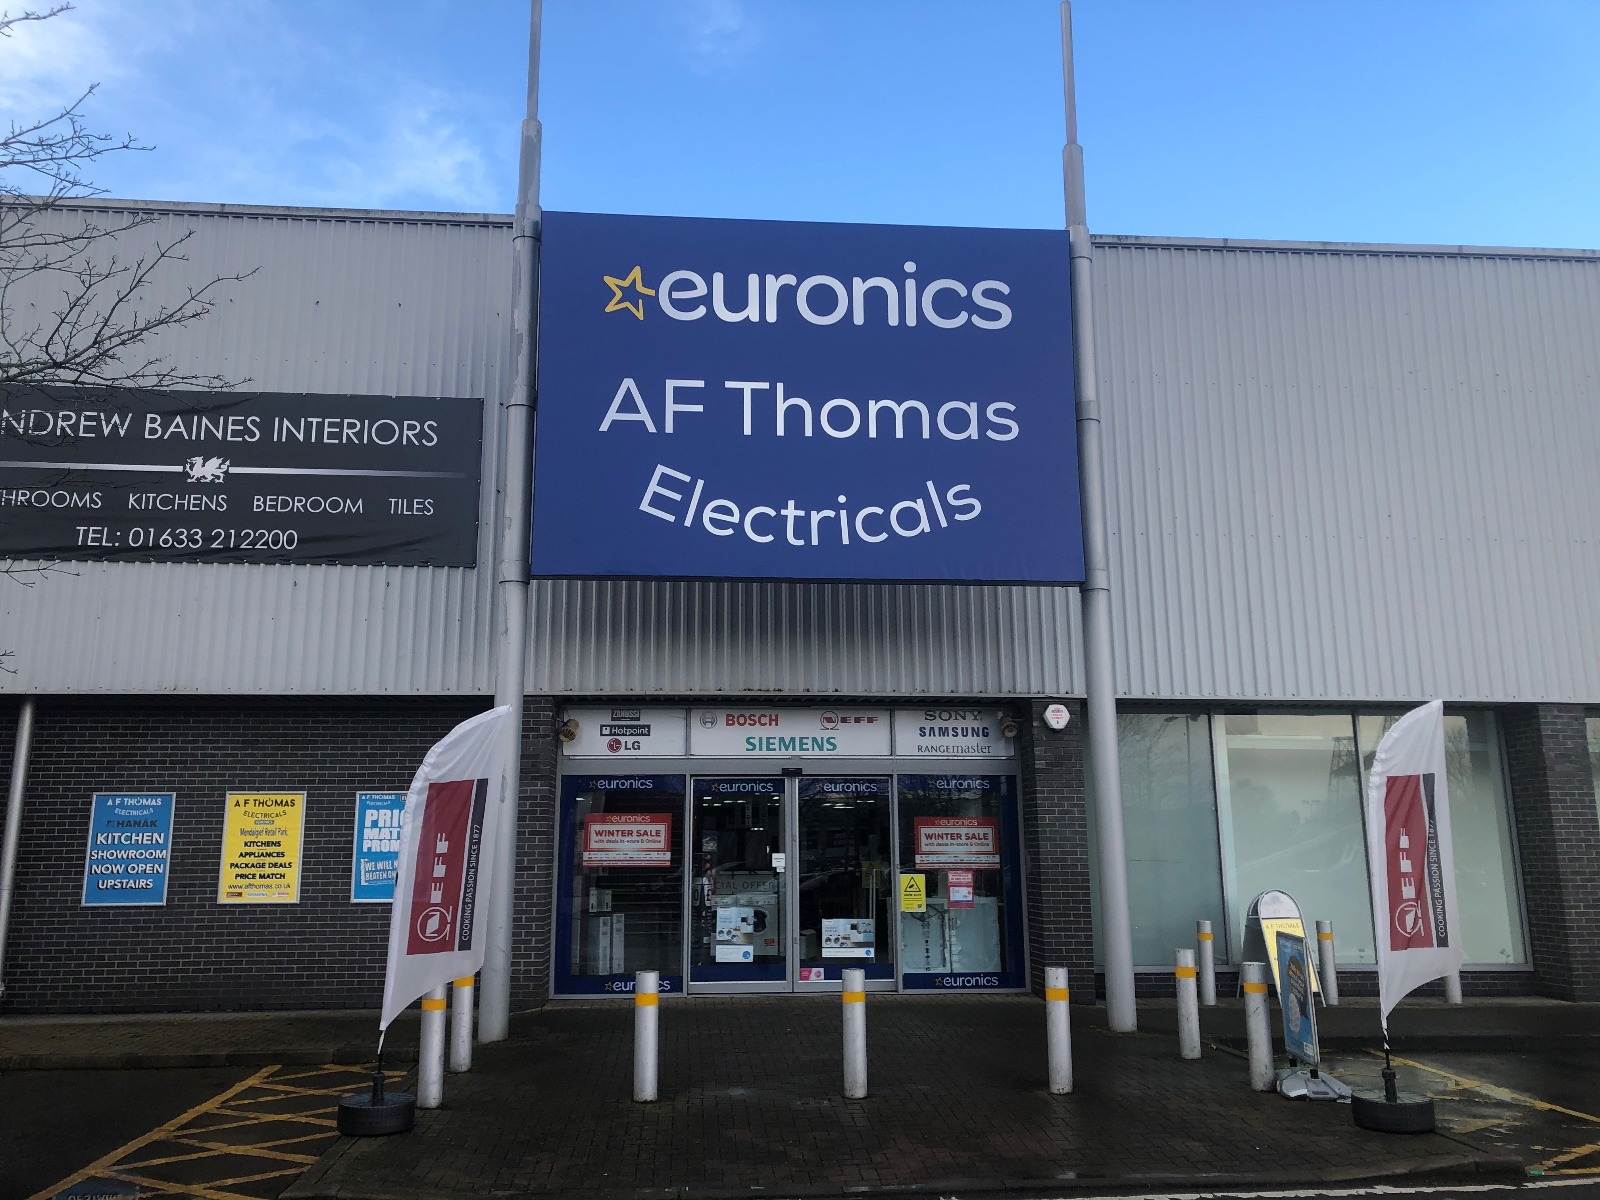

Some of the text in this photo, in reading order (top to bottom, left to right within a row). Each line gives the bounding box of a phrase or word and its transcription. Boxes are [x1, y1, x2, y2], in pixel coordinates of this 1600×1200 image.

[658, 261, 1012, 330] euronics
[599, 378, 1019, 441] AF Thomas
[144, 414, 260, 442] BAINES
[273, 418, 438, 446] INTERIORS
[0, 489, 434, 516] HROOMS KITCHENS BEDROOM TILES
[639, 464, 982, 546] Electricals
[76, 526, 298, 550] TEL: 01633 212200
[726, 714, 778, 726] BOSCH
[820, 711, 878, 730] NEFF
[924, 710, 982, 722] SONY
[612, 726, 649, 736] Hotpoint
[918, 726, 990, 738] SAMSUNG
[624, 740, 641, 750] LG
[745, 736, 838, 752] SIEMENS
[597, 778, 653, 789] euronics
[719, 781, 774, 792] euronics
[824, 780, 878, 792] euronics
[936, 778, 990, 790] euronics
[124, 797, 162, 806] THOMAS
[234, 798, 296, 808] A F THOMAS
[115, 808, 154, 816] ELECTRICALS
[242, 810, 287, 818] ELECTRICALS
[612, 814, 650, 823] euronics
[940, 817, 978, 826] euronics
[96, 833, 164, 844] KITCHEN
[594, 830, 662, 838] WINTER SALE
[924, 832, 989, 841] WINTER SALE
[90, 850, 166, 860] SHOWROOM
[1429, 840, 1437, 862] SINCE
[91, 864, 163, 874] NOW OPEN
[98, 879, 154, 889] UPSTAIRS
[417, 833, 452, 941] NEFF
[466, 869, 475, 902] PASSION
[1432, 866, 1441, 898] PASSION
[462, 904, 472, 941] COOKING
[1436, 900, 1446, 937] COOKING
[612, 980, 670, 991] eurcs
[943, 974, 998, 986] euronics
